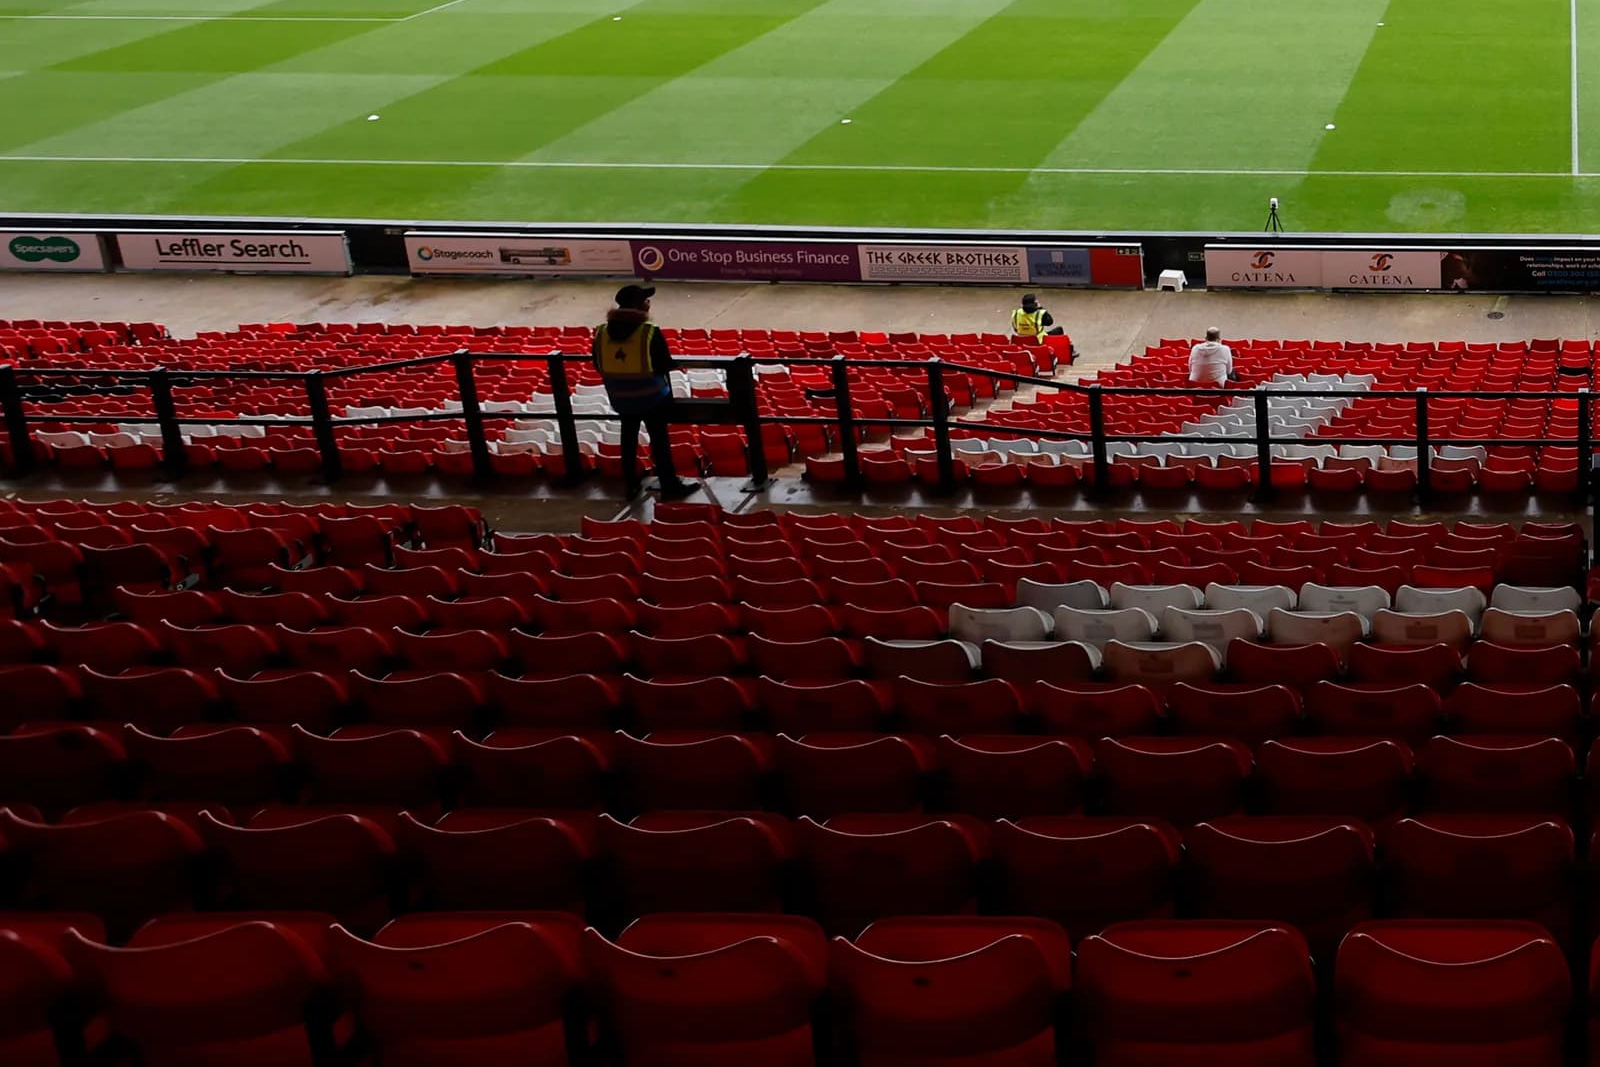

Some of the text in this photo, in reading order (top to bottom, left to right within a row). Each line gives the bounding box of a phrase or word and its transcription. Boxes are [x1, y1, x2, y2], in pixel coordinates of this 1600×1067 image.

[14, 243, 75, 255] Specsavers
[155, 238, 310, 258] Leffler Search.
[433, 248, 494, 261] Stagecoach
[668, 248, 850, 266] One Stop Business Finance
[866, 251, 1020, 266] THE GREEK BROTHERS
[1231, 271, 1296, 283] CATENA
[1349, 274, 1413, 285] CATENA
